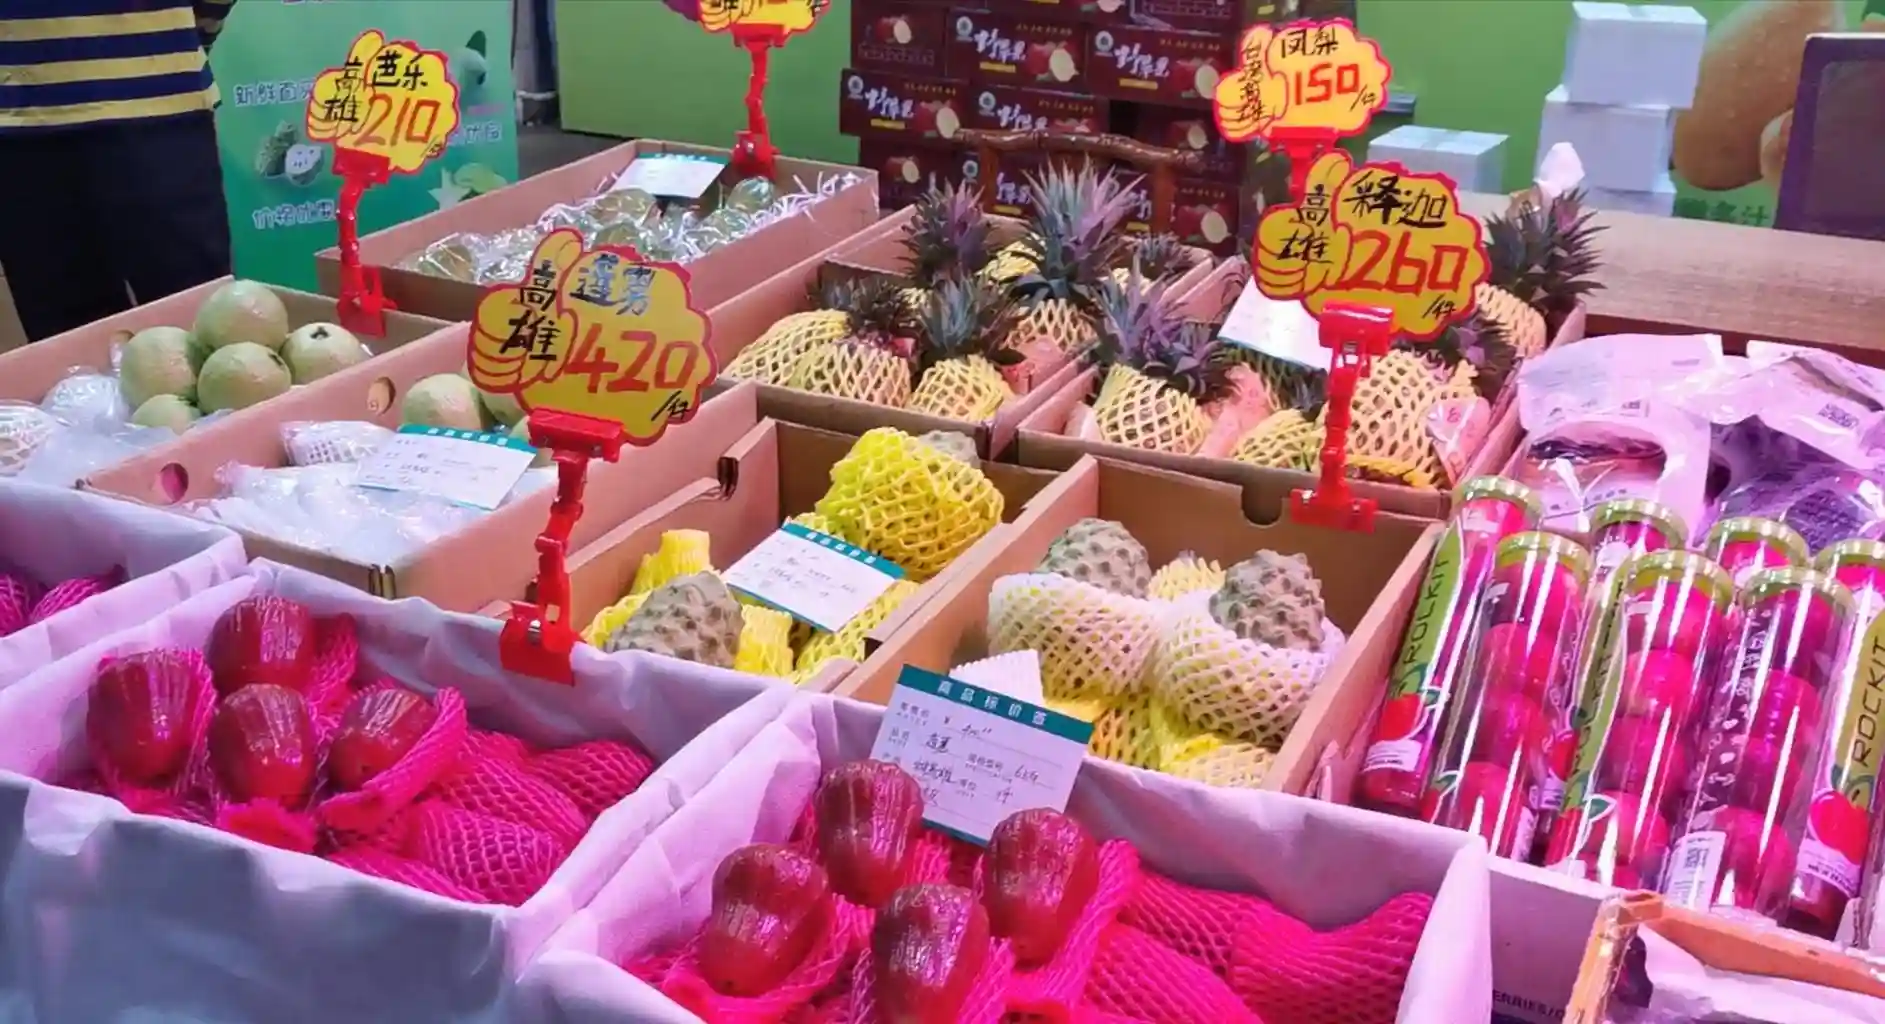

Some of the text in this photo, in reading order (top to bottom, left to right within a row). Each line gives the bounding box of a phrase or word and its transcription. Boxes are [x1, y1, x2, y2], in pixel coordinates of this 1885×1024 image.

[372, 50, 428, 91] 芭乐
[1295, 63, 1360, 106] 150
[353, 93, 441, 147] 210
[1277, 184, 1333, 264] 高雄
[1343, 170, 1448, 228] 释迦
[1332, 229, 1470, 295] 260
[500, 260, 561, 361] 高雄
[564, 323, 699, 394] 420
